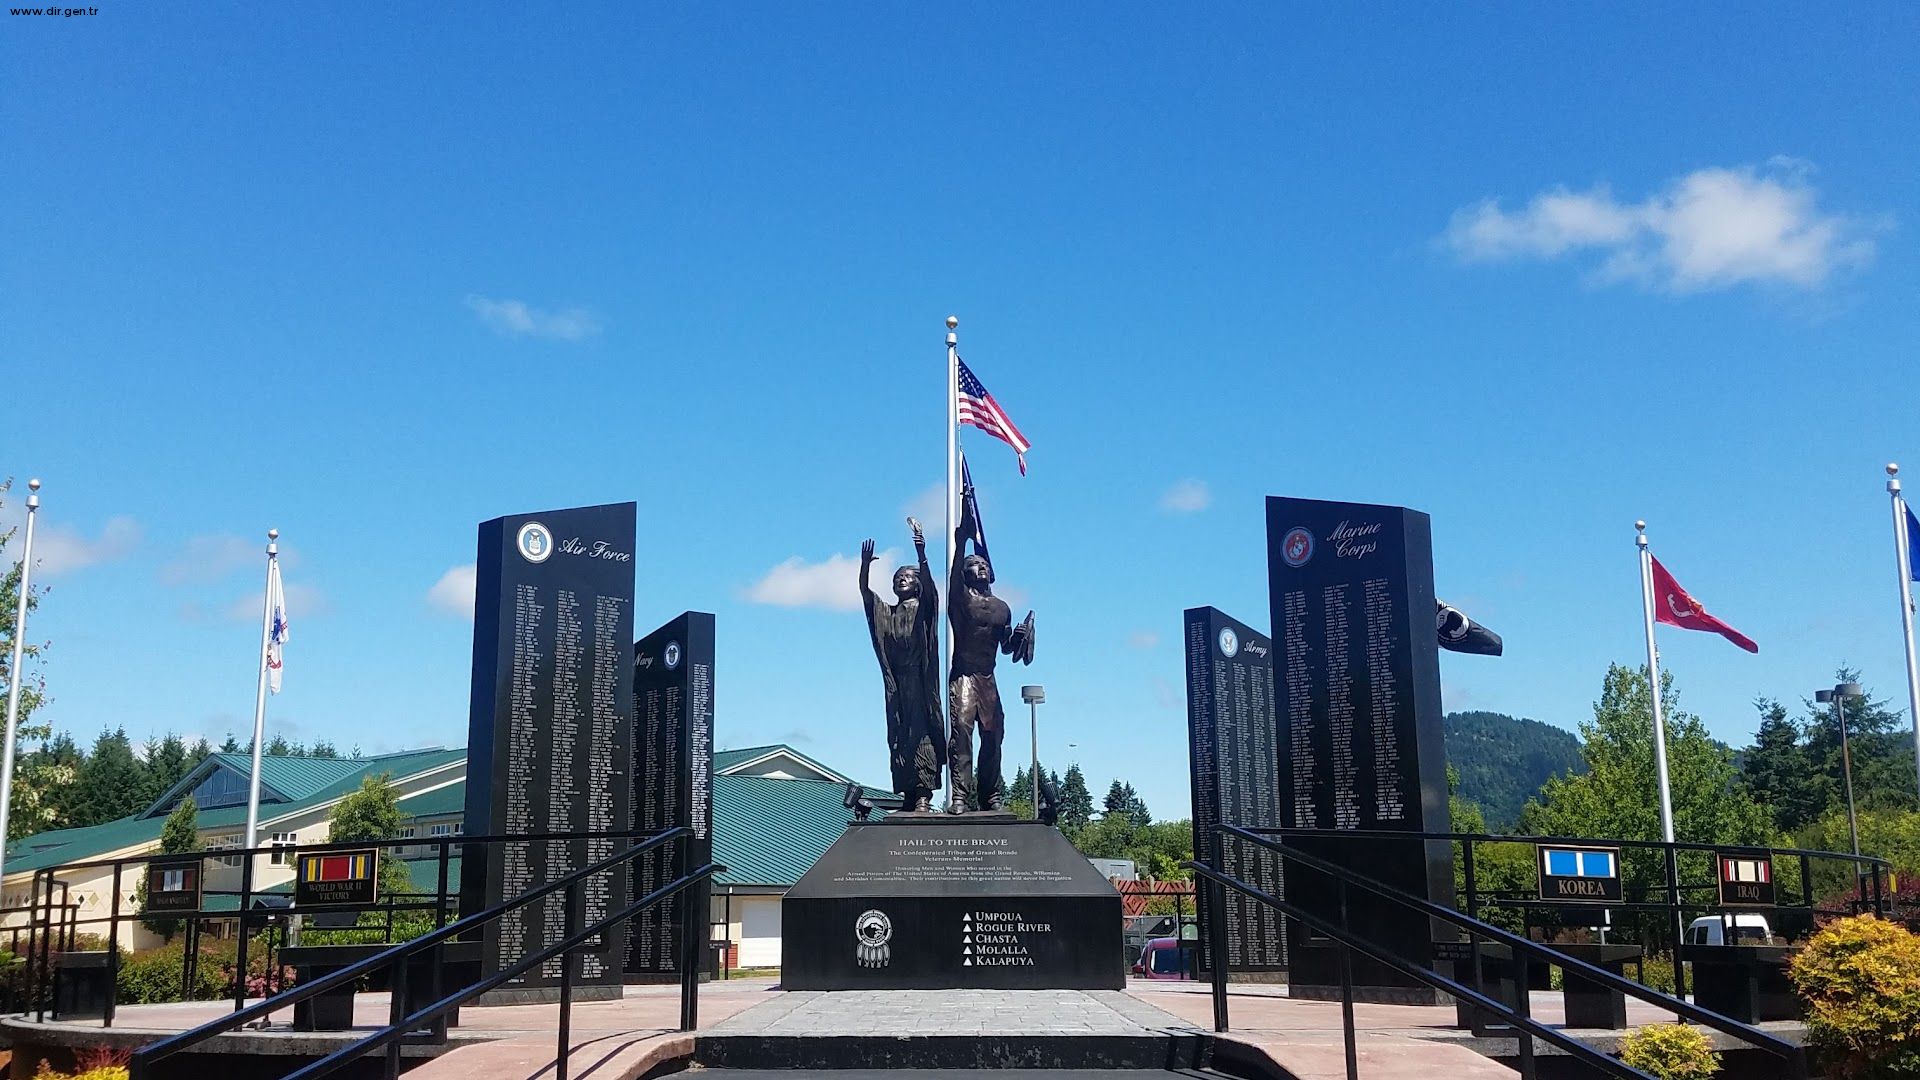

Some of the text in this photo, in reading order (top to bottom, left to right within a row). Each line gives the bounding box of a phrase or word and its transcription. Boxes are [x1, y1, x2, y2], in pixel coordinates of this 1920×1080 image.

[1326, 520, 1382, 542] Marine
[559, 537, 630, 563] Air Force
[1335, 538, 1377, 560] Corps
[1244, 640, 1267, 658] Army
[633, 652, 653, 669] Navy
[899, 839, 1009, 847] HAIL TO THE BRAVE
[308, 884, 336, 893] WORLD
[337, 882, 355, 892] WAR
[319, 891, 351, 901] VICTORY
[1558, 879, 1605, 897] KOREA
[1737, 885, 1760, 899] IRAQ
